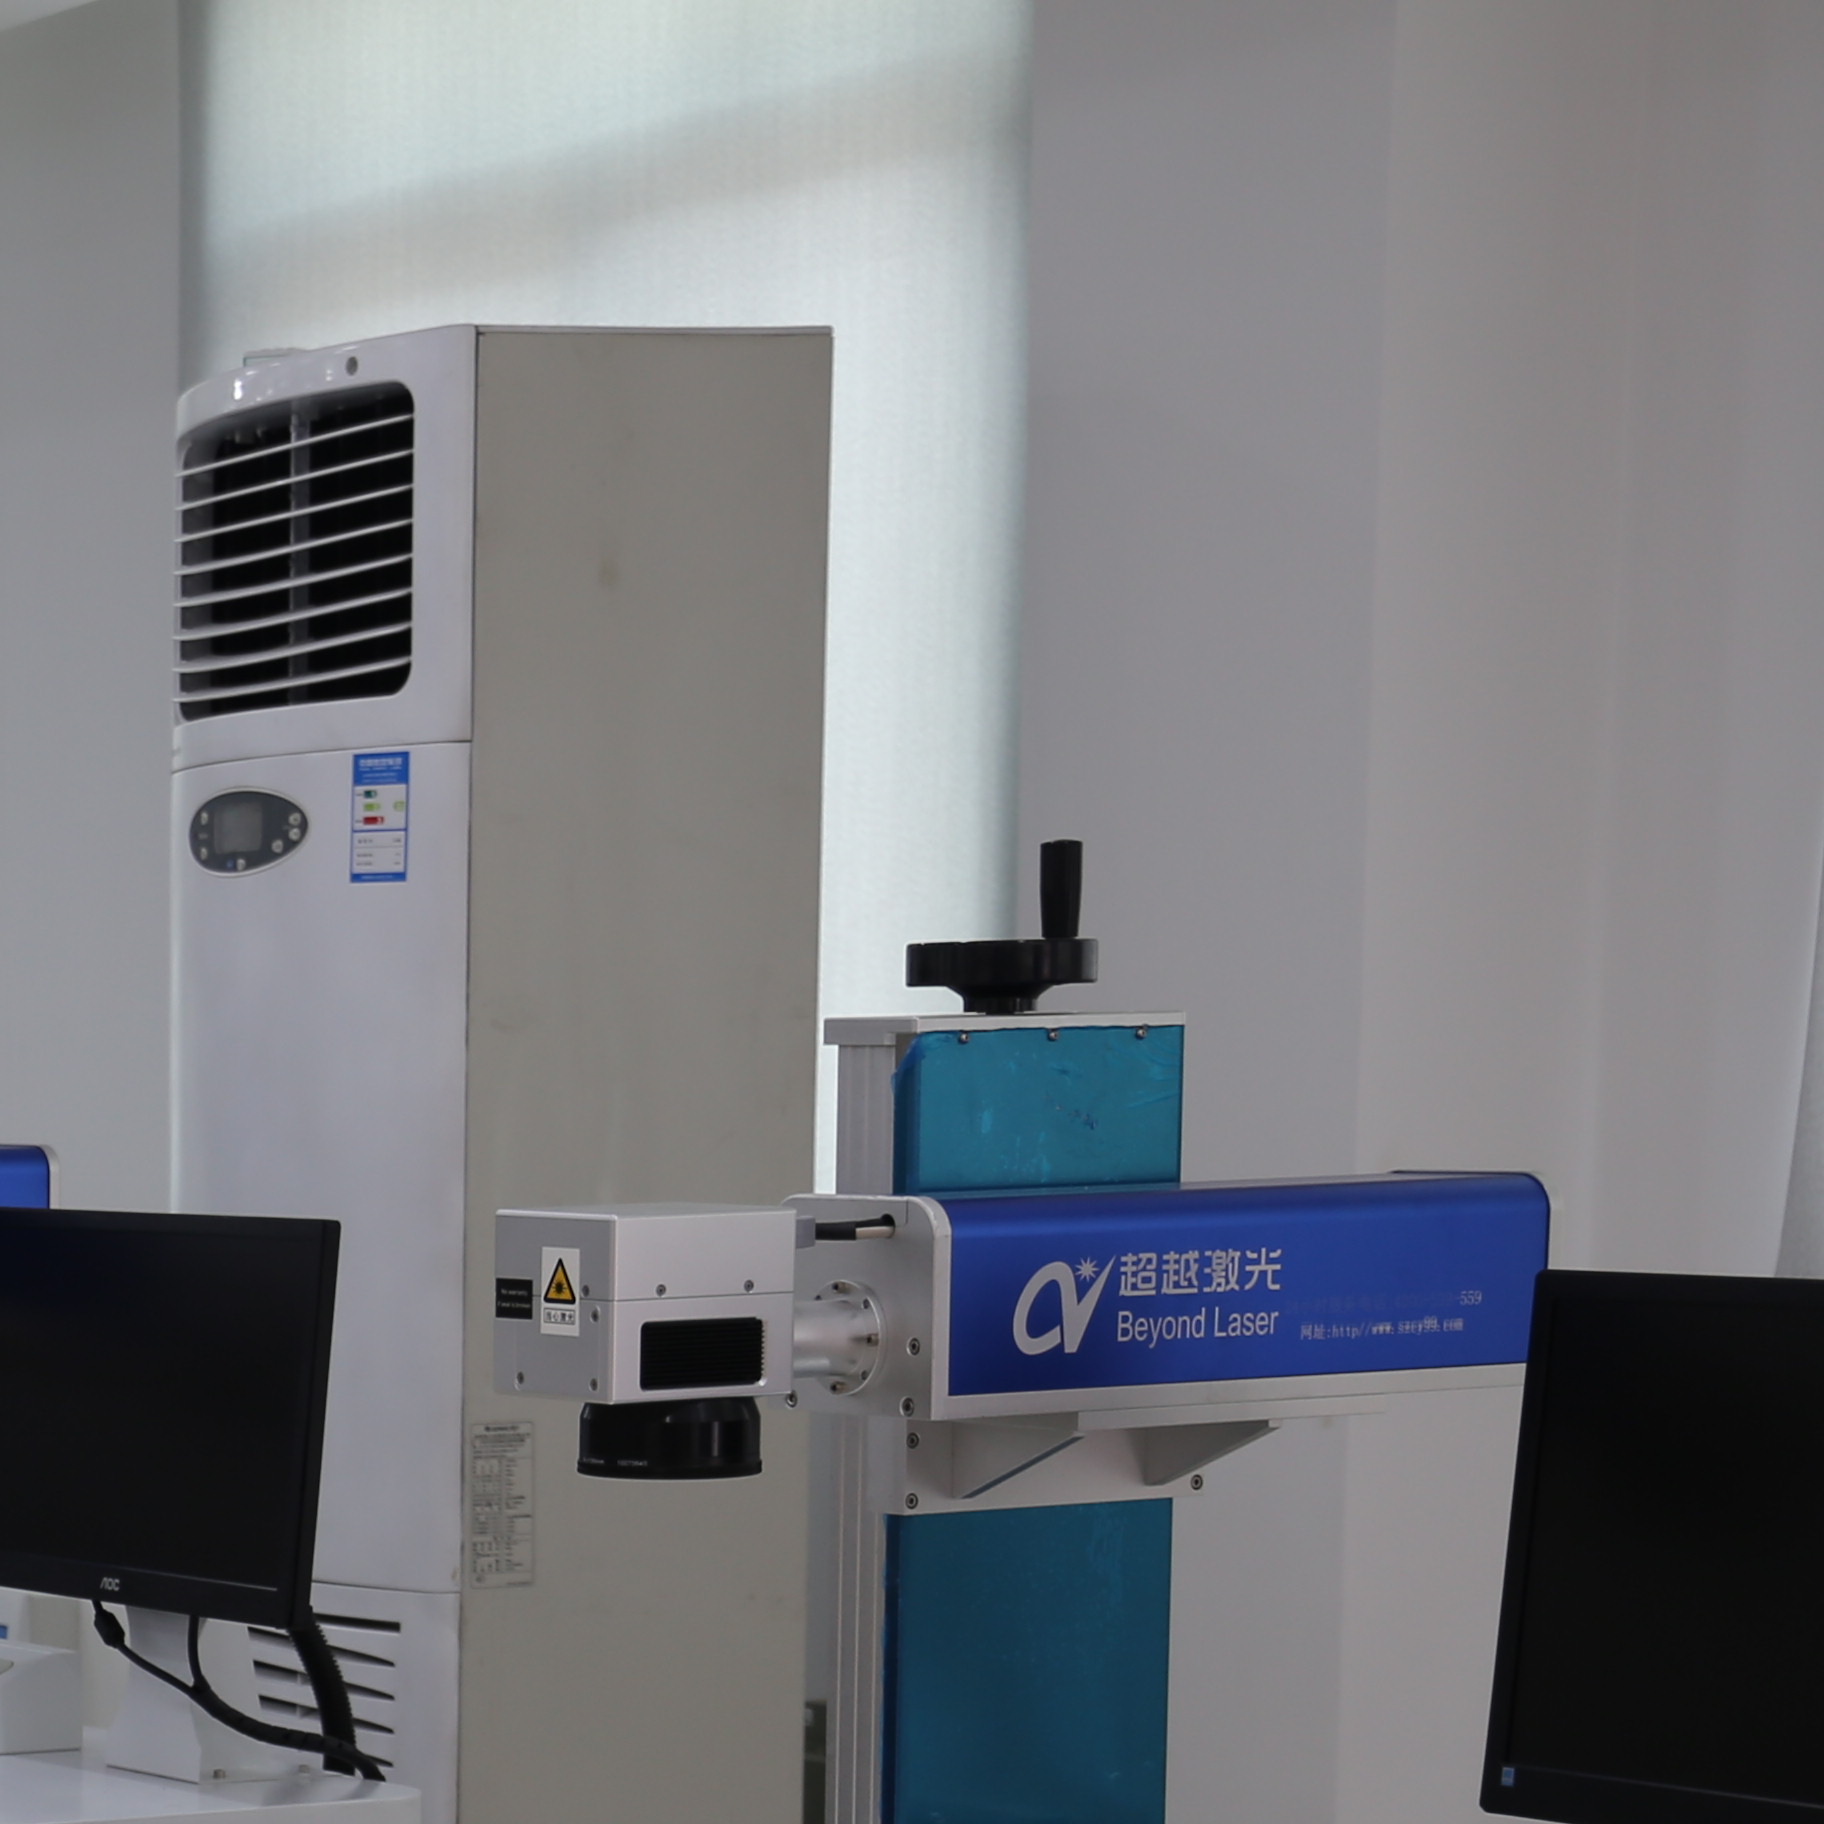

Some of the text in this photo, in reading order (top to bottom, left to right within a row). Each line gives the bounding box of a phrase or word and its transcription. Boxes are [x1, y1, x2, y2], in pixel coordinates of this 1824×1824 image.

[1119, 1247, 1282, 1297] 超越激光
[1116, 1305, 1280, 1349] Beyond Laser
